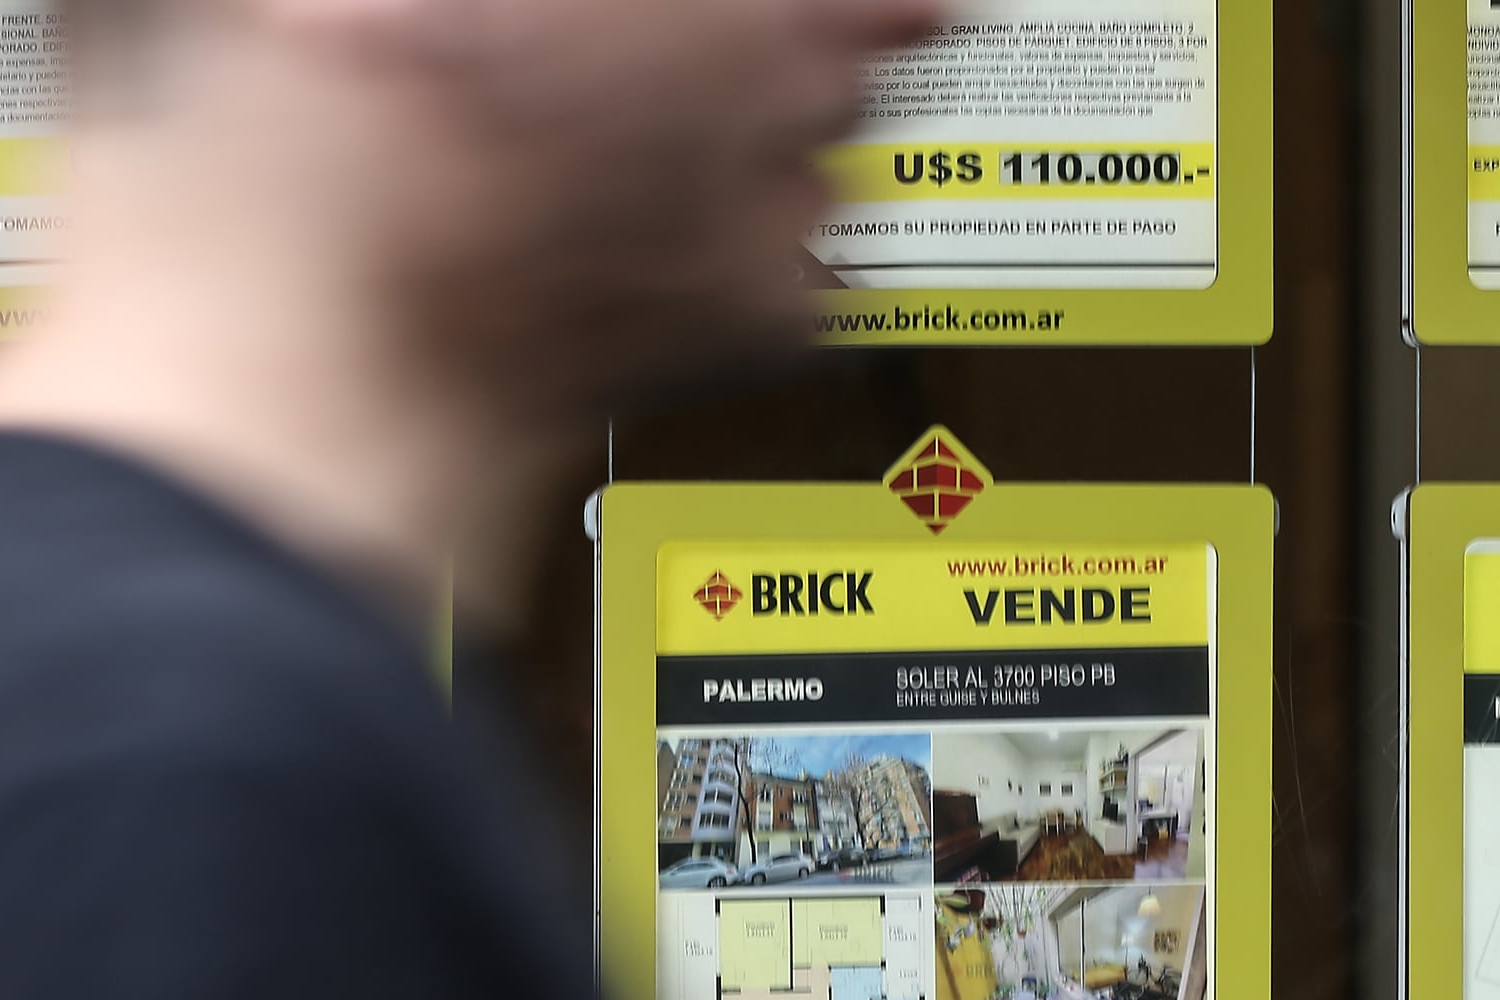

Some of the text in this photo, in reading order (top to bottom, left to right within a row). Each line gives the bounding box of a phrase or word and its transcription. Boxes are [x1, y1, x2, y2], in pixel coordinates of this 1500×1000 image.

[952, 26, 979, 35] GRAN
[893, 148, 1210, 187] U$S 110.000.-
[819, 222, 898, 237] TOMAMOS
[905, 222, 924, 237] SU
[930, 222, 1020, 237] PROPIEDAD
[1026, 222, 1045, 237] EN
[1052, 222, 1101, 237] PARTE
[1107, 222, 1127, 237] DE
[1133, 222, 1177, 237] PAGO
[814, 305, 1064, 331] www.brick.com.ar
[947, 554, 1168, 578] www.brick.com.ar
[751, 571, 875, 617] BRICK
[964, 587, 1152, 626] VENDE
[703, 677, 824, 703] PALERMO
[896, 664, 1116, 691] SOLER AL 3700 PISO PB
[896, 692, 935, 708] ENTRE
[980, 691, 988, 706] Y
[992, 691, 1041, 706] BULNES
